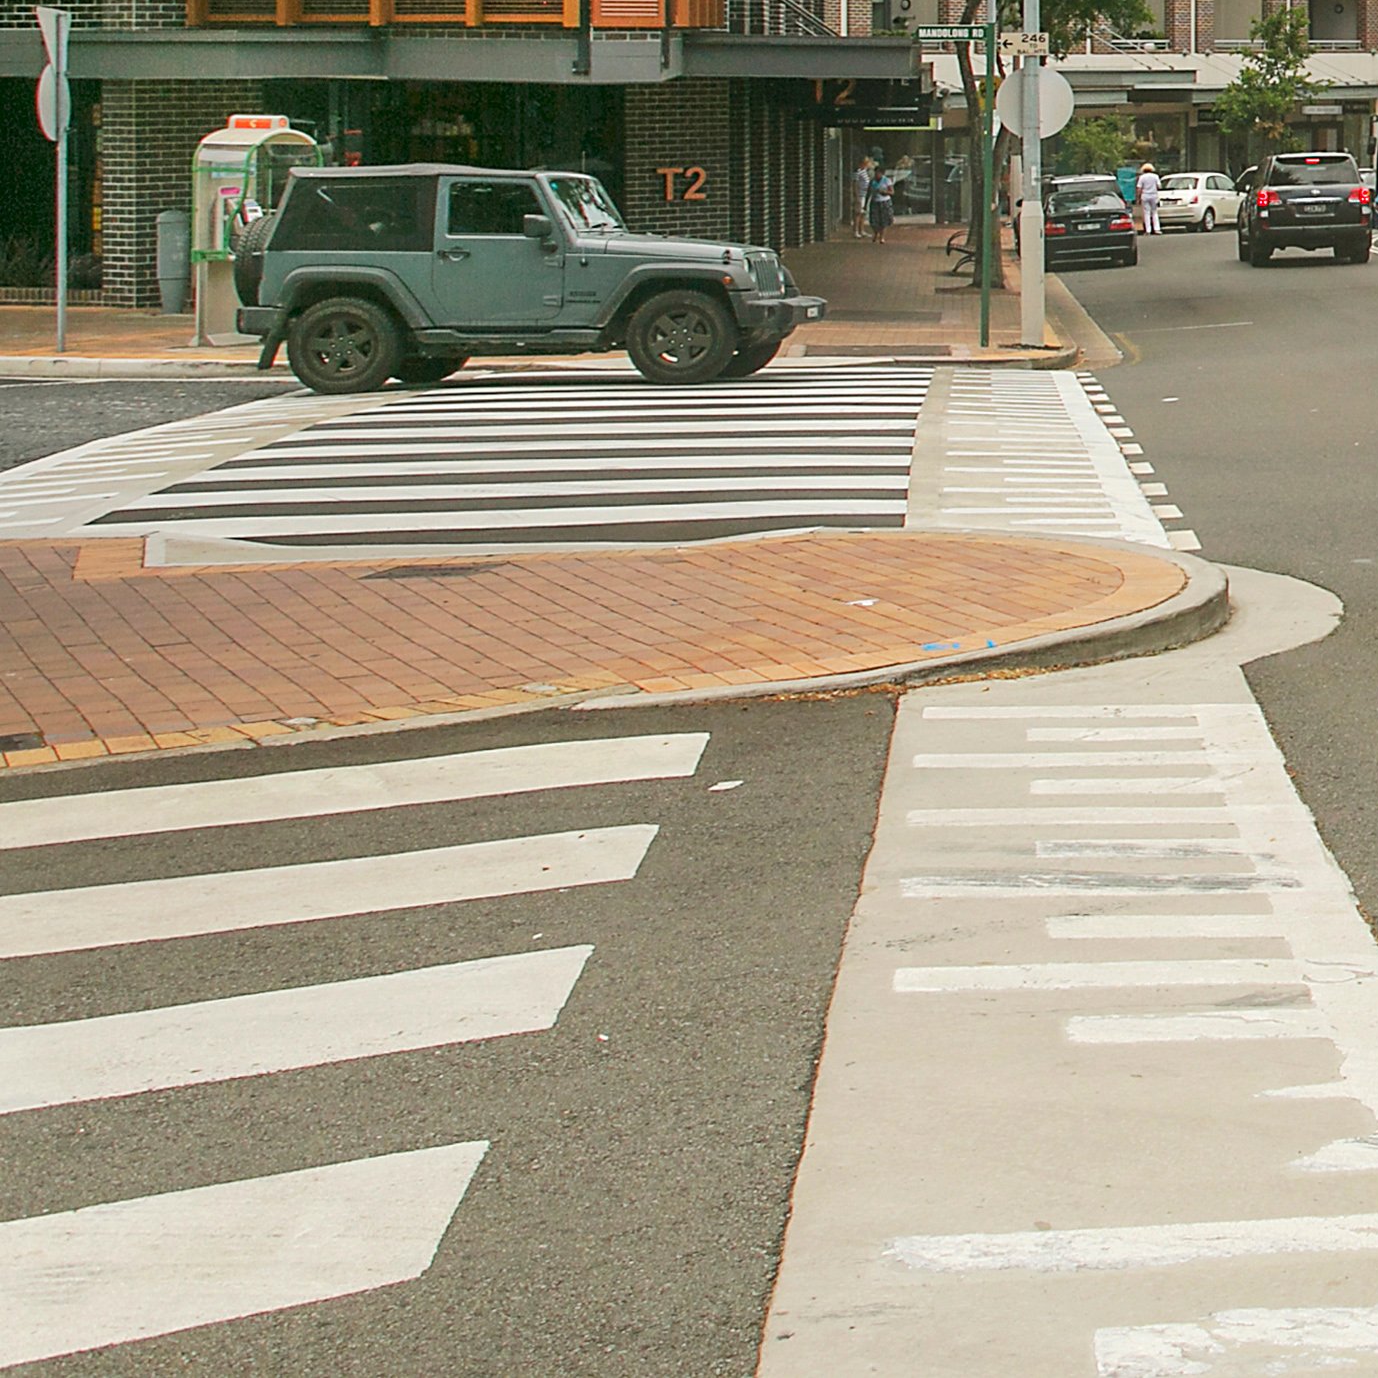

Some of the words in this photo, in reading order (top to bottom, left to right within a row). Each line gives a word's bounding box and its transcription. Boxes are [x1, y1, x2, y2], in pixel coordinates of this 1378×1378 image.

[972, 29, 984, 37] RD
[1021, 33, 1046, 43] 246
[656, 166, 707, 202] T2
